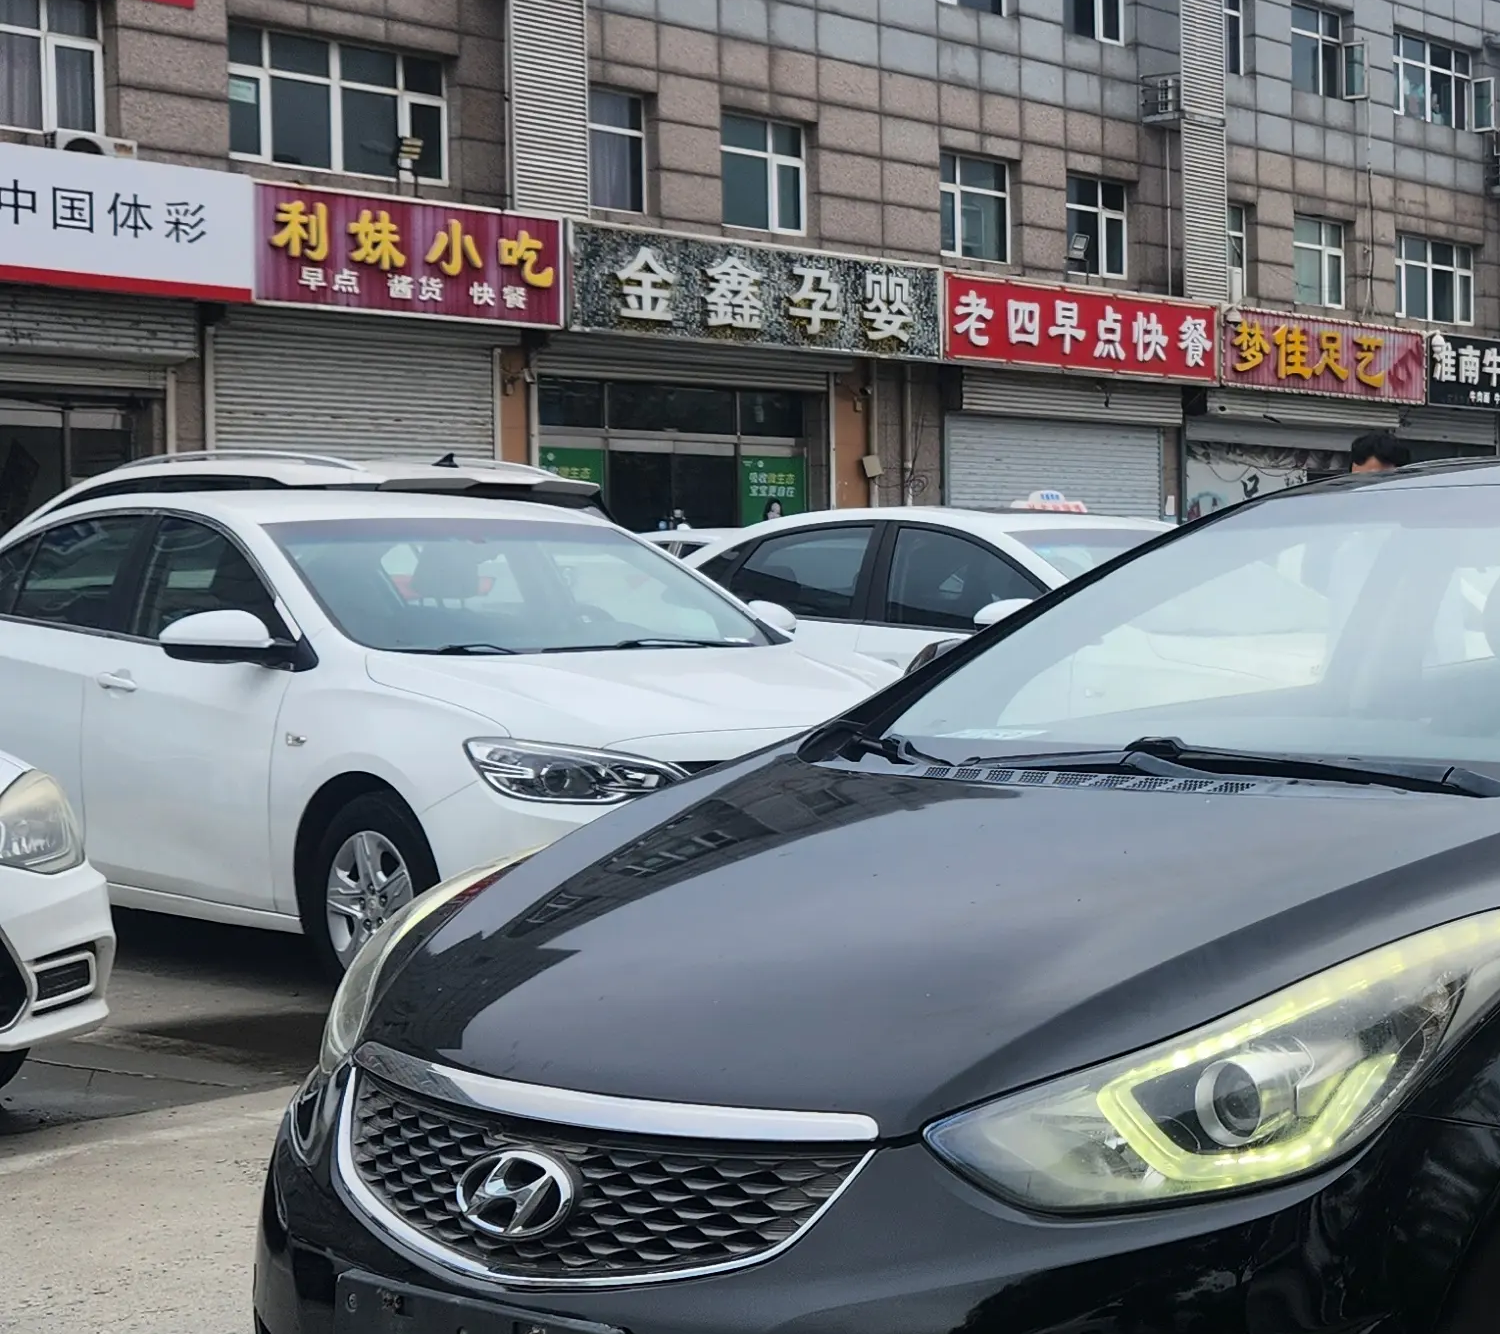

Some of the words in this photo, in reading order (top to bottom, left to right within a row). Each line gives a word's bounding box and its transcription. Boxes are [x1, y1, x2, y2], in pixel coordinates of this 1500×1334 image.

[0, 179, 206, 243] 中国体彩
[270, 201, 554, 288] 利妹小吃
[298, 266, 360, 293] 早点
[387, 273, 444, 302] 酱货
[469, 282, 528, 309] 快餐
[616, 246, 912, 343] 金鑫孕婴
[953, 290, 1213, 368] 老四早点快餐
[1232, 319, 1386, 388] 梦佳足艺
